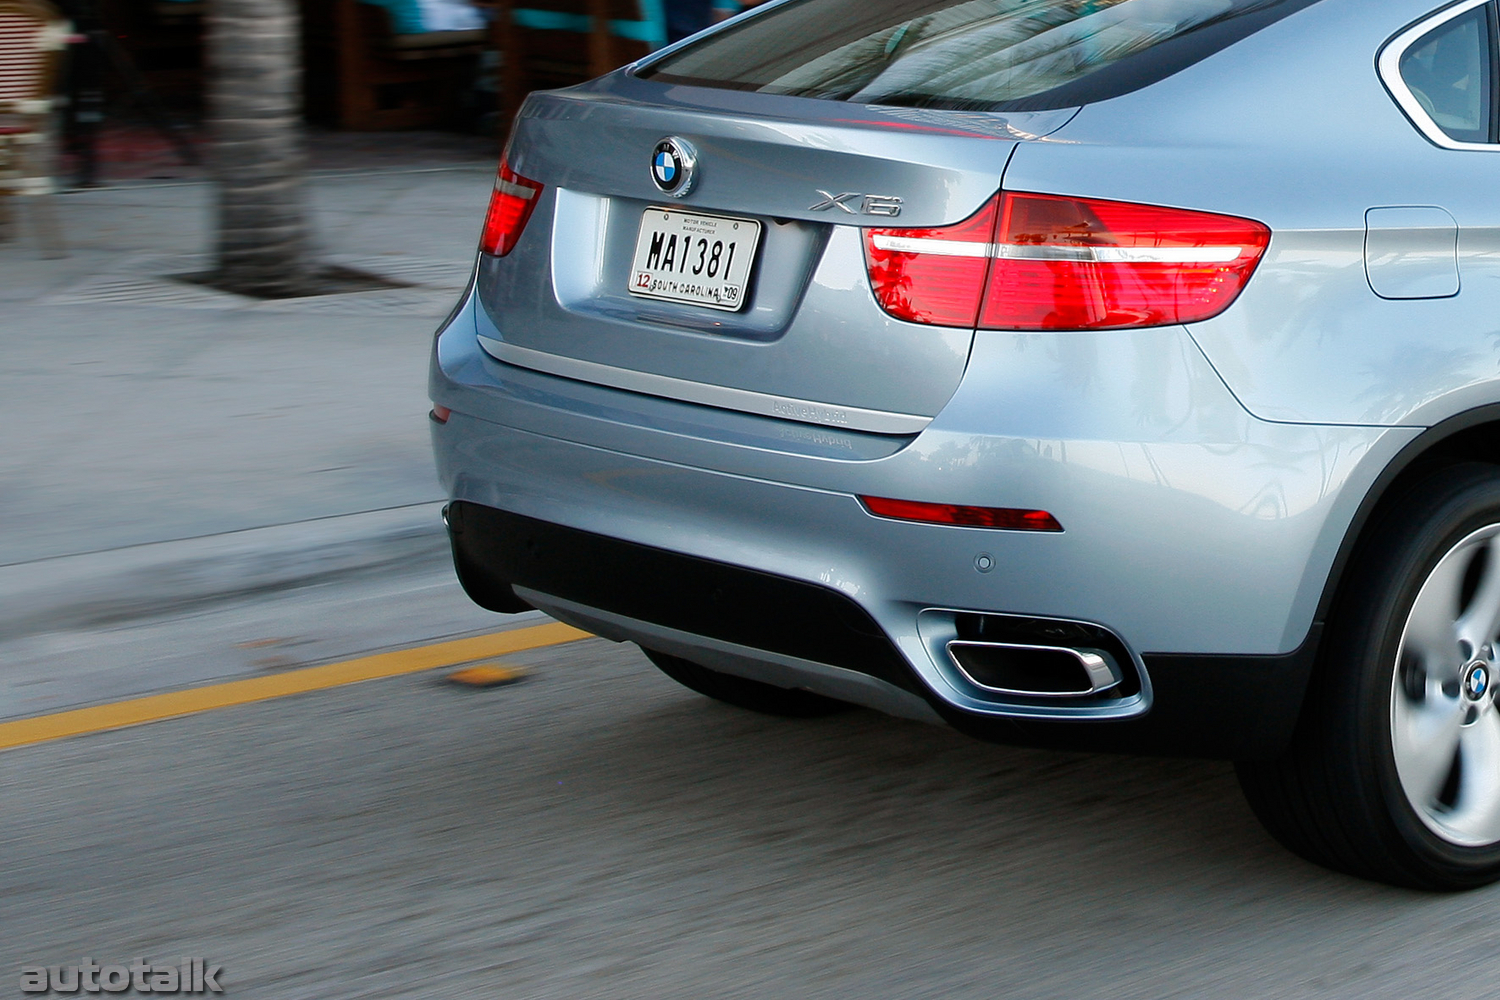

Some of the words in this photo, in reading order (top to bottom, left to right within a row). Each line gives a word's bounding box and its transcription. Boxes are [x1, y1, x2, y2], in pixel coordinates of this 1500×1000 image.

[808, 189, 903, 217] X6
[682, 226, 716, 235] MANUFACTURER
[699, 220, 717, 228] VEHICLE
[647, 231, 736, 280] MA1381
[636, 274, 651, 288] 12
[652, 279, 677, 292] SOUTH
[679, 283, 719, 299] CAROLINA
